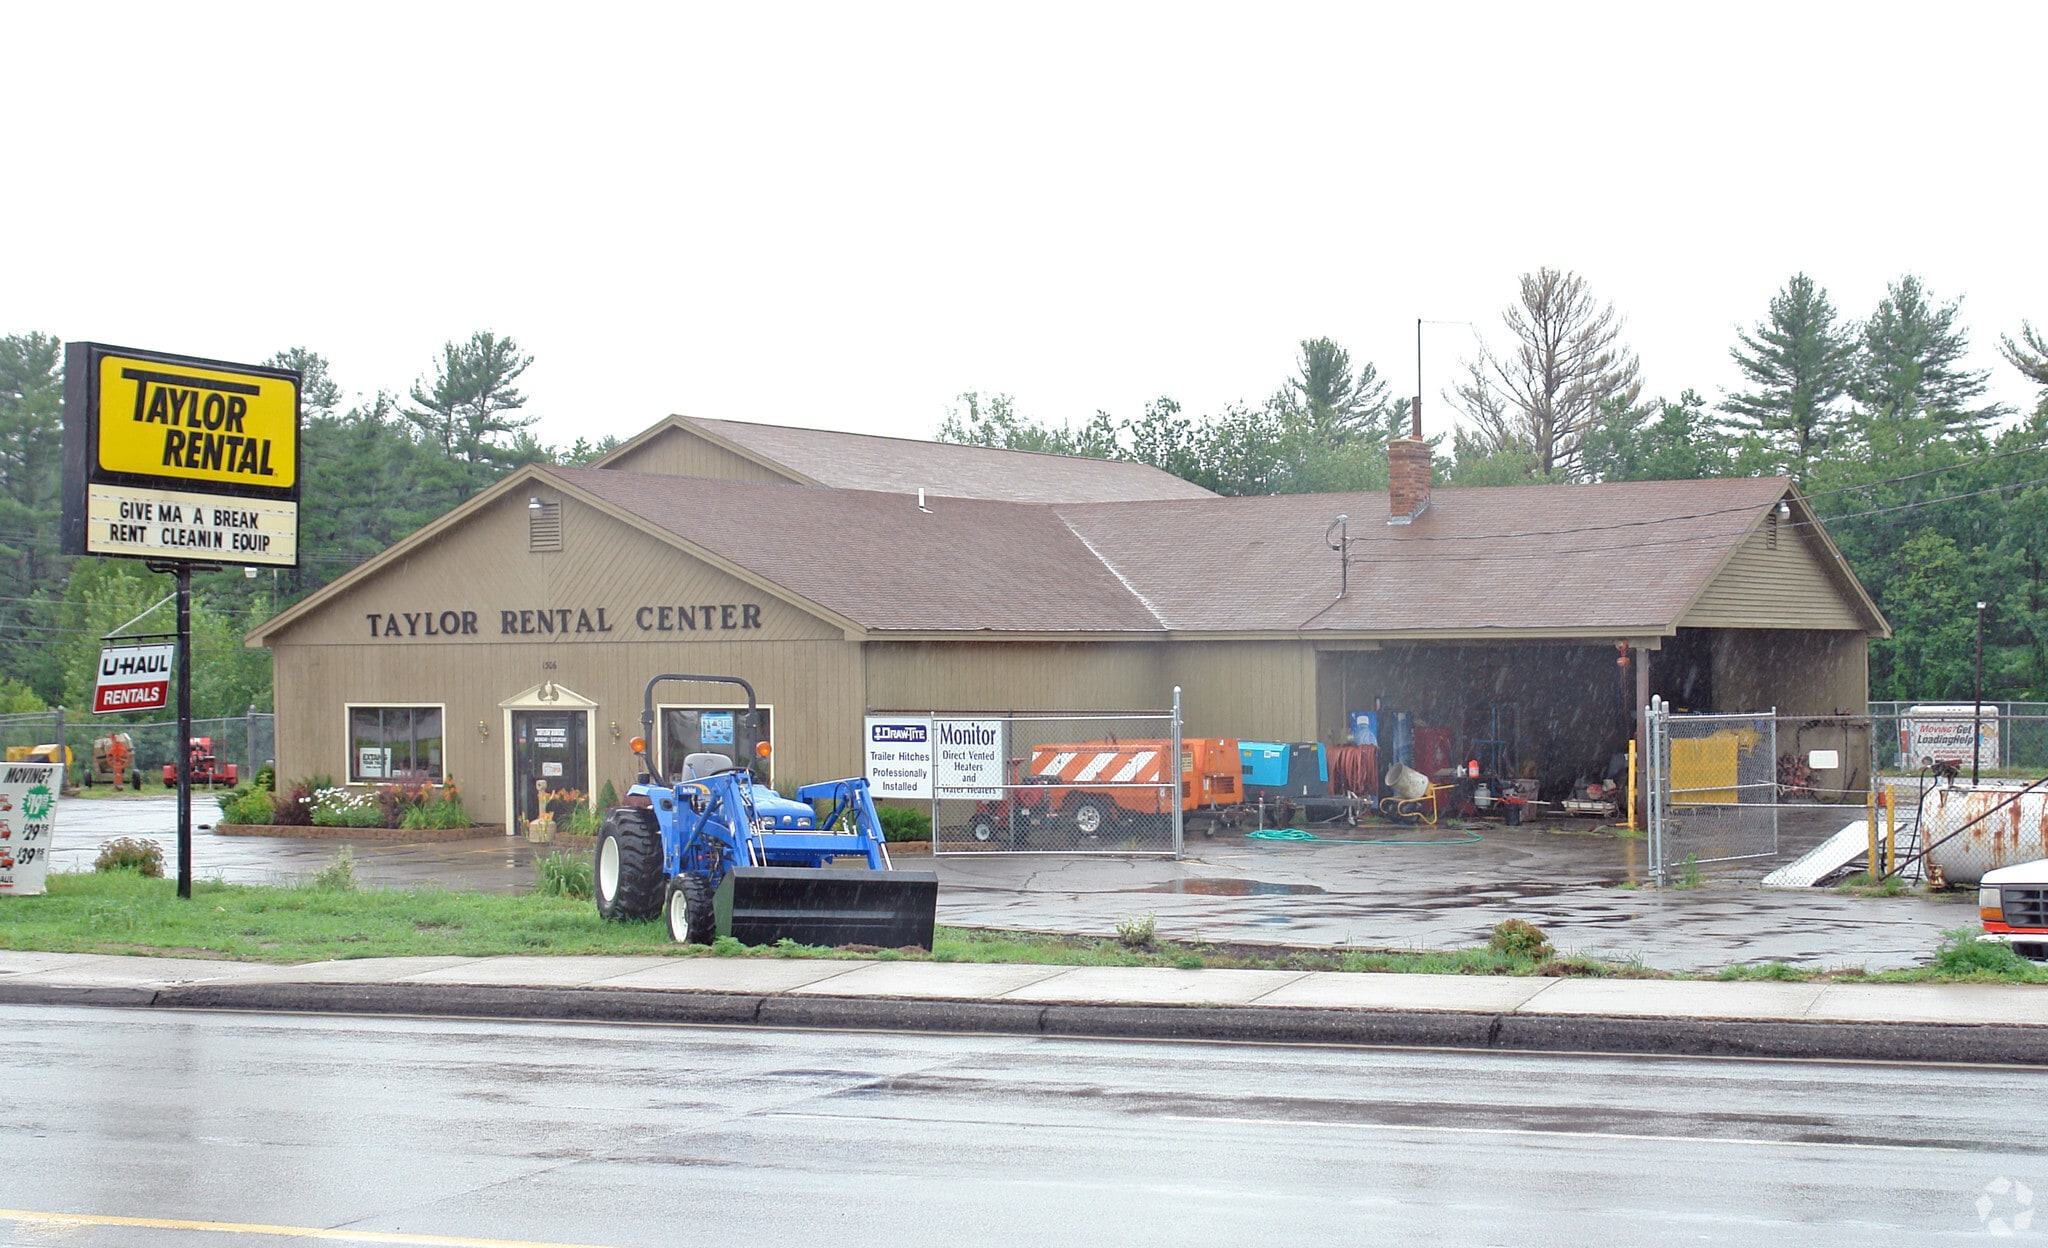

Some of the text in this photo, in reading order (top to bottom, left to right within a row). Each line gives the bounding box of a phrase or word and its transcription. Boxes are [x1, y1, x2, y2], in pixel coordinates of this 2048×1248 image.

[121, 367, 260, 433] TAYLOR
[162, 428, 274, 475] RENTAL
[120, 501, 259, 530] GIVE MA A BREAK
[110, 523, 271, 552] RENT CLEANIN EQUIP
[366, 604, 762, 637] TAYLOR RENTAL CENTER
[103, 655, 168, 676] U-HAUL
[103, 686, 161, 705] RENTALS
[882, 727, 926, 740] DRAW-TITE
[940, 722, 996, 746] Monitor
[1956, 725, 1972, 734] Get
[870, 752, 930, 761] Trailer Hitches
[942, 750, 995, 760] Direct Vented
[3, 767, 53, 784] MOVING?
[873, 768, 927, 779] Professionally
[954, 762, 983, 772] Heaters
[882, 782, 918, 791] Installed
[962, 774, 976, 782] and
